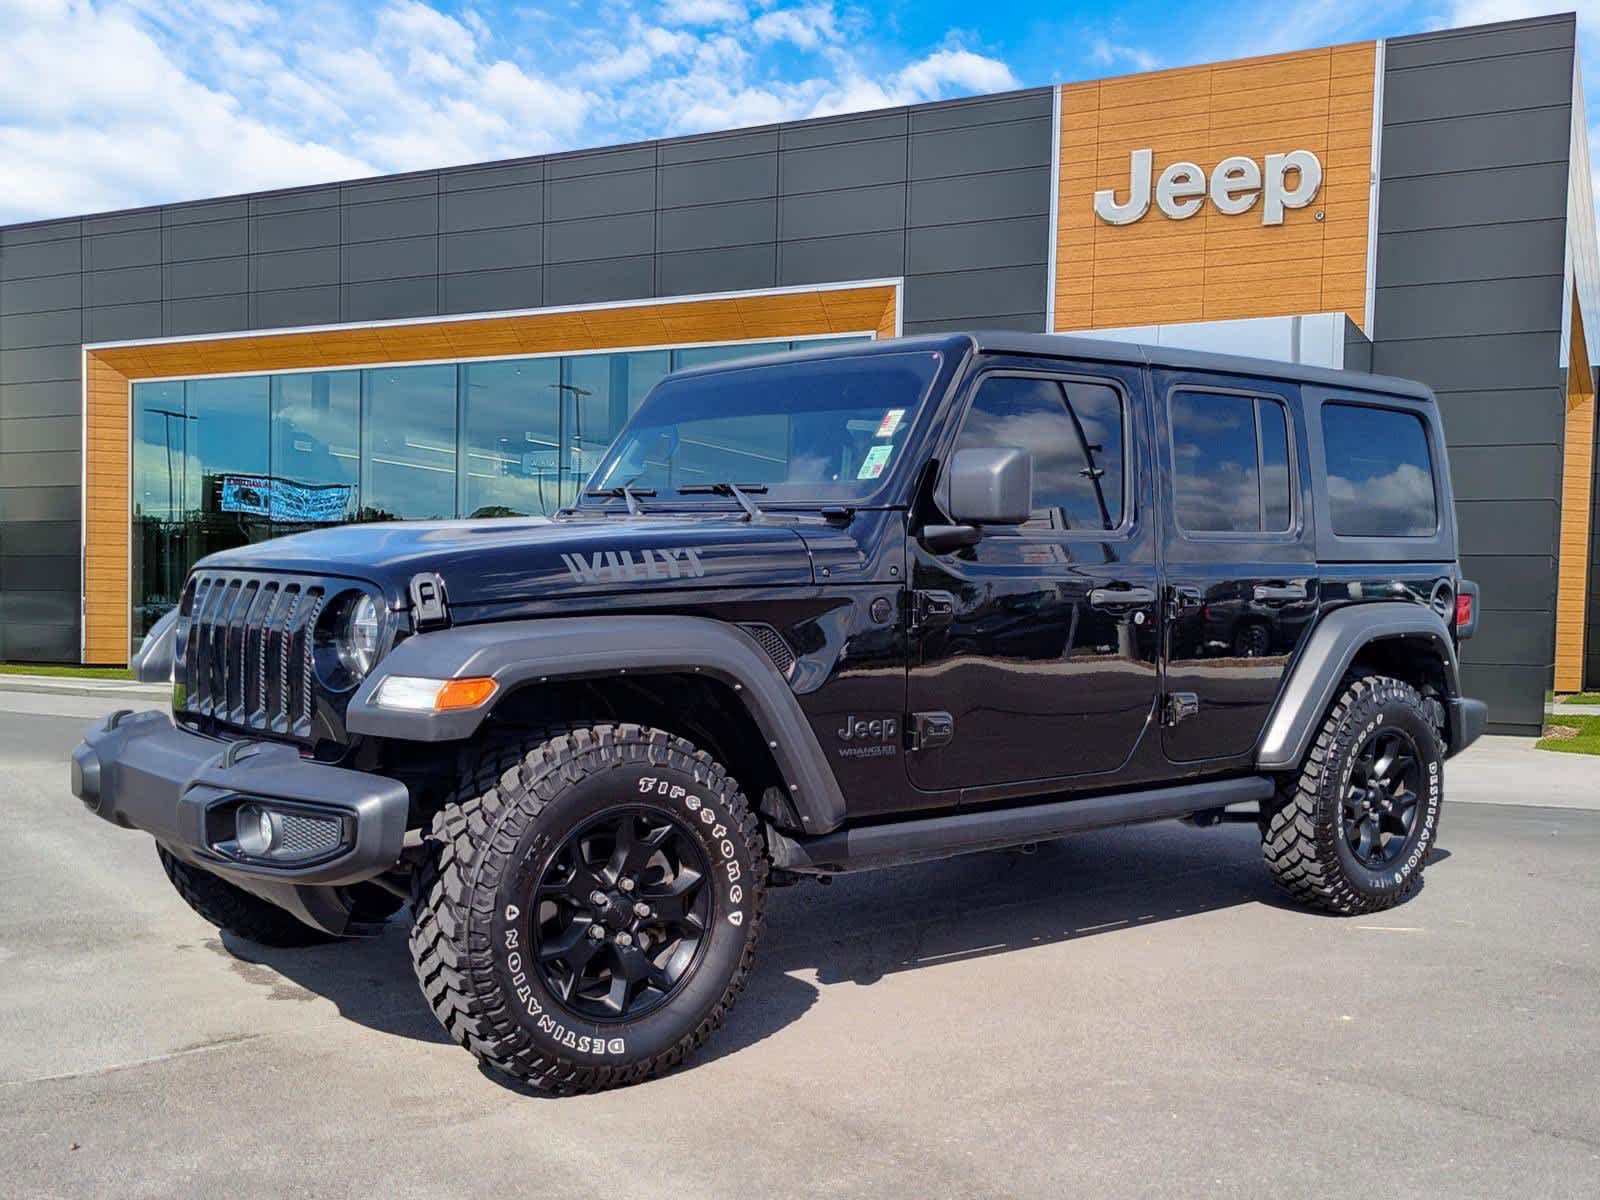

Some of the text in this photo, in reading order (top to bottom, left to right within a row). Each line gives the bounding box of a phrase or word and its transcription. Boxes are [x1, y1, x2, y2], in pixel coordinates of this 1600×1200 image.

[1094, 148, 1323, 226] Jeep
[838, 715, 897, 741] Jeep
[638, 776, 744, 904] Firestone
[505, 929, 626, 1055] DESTINATION
